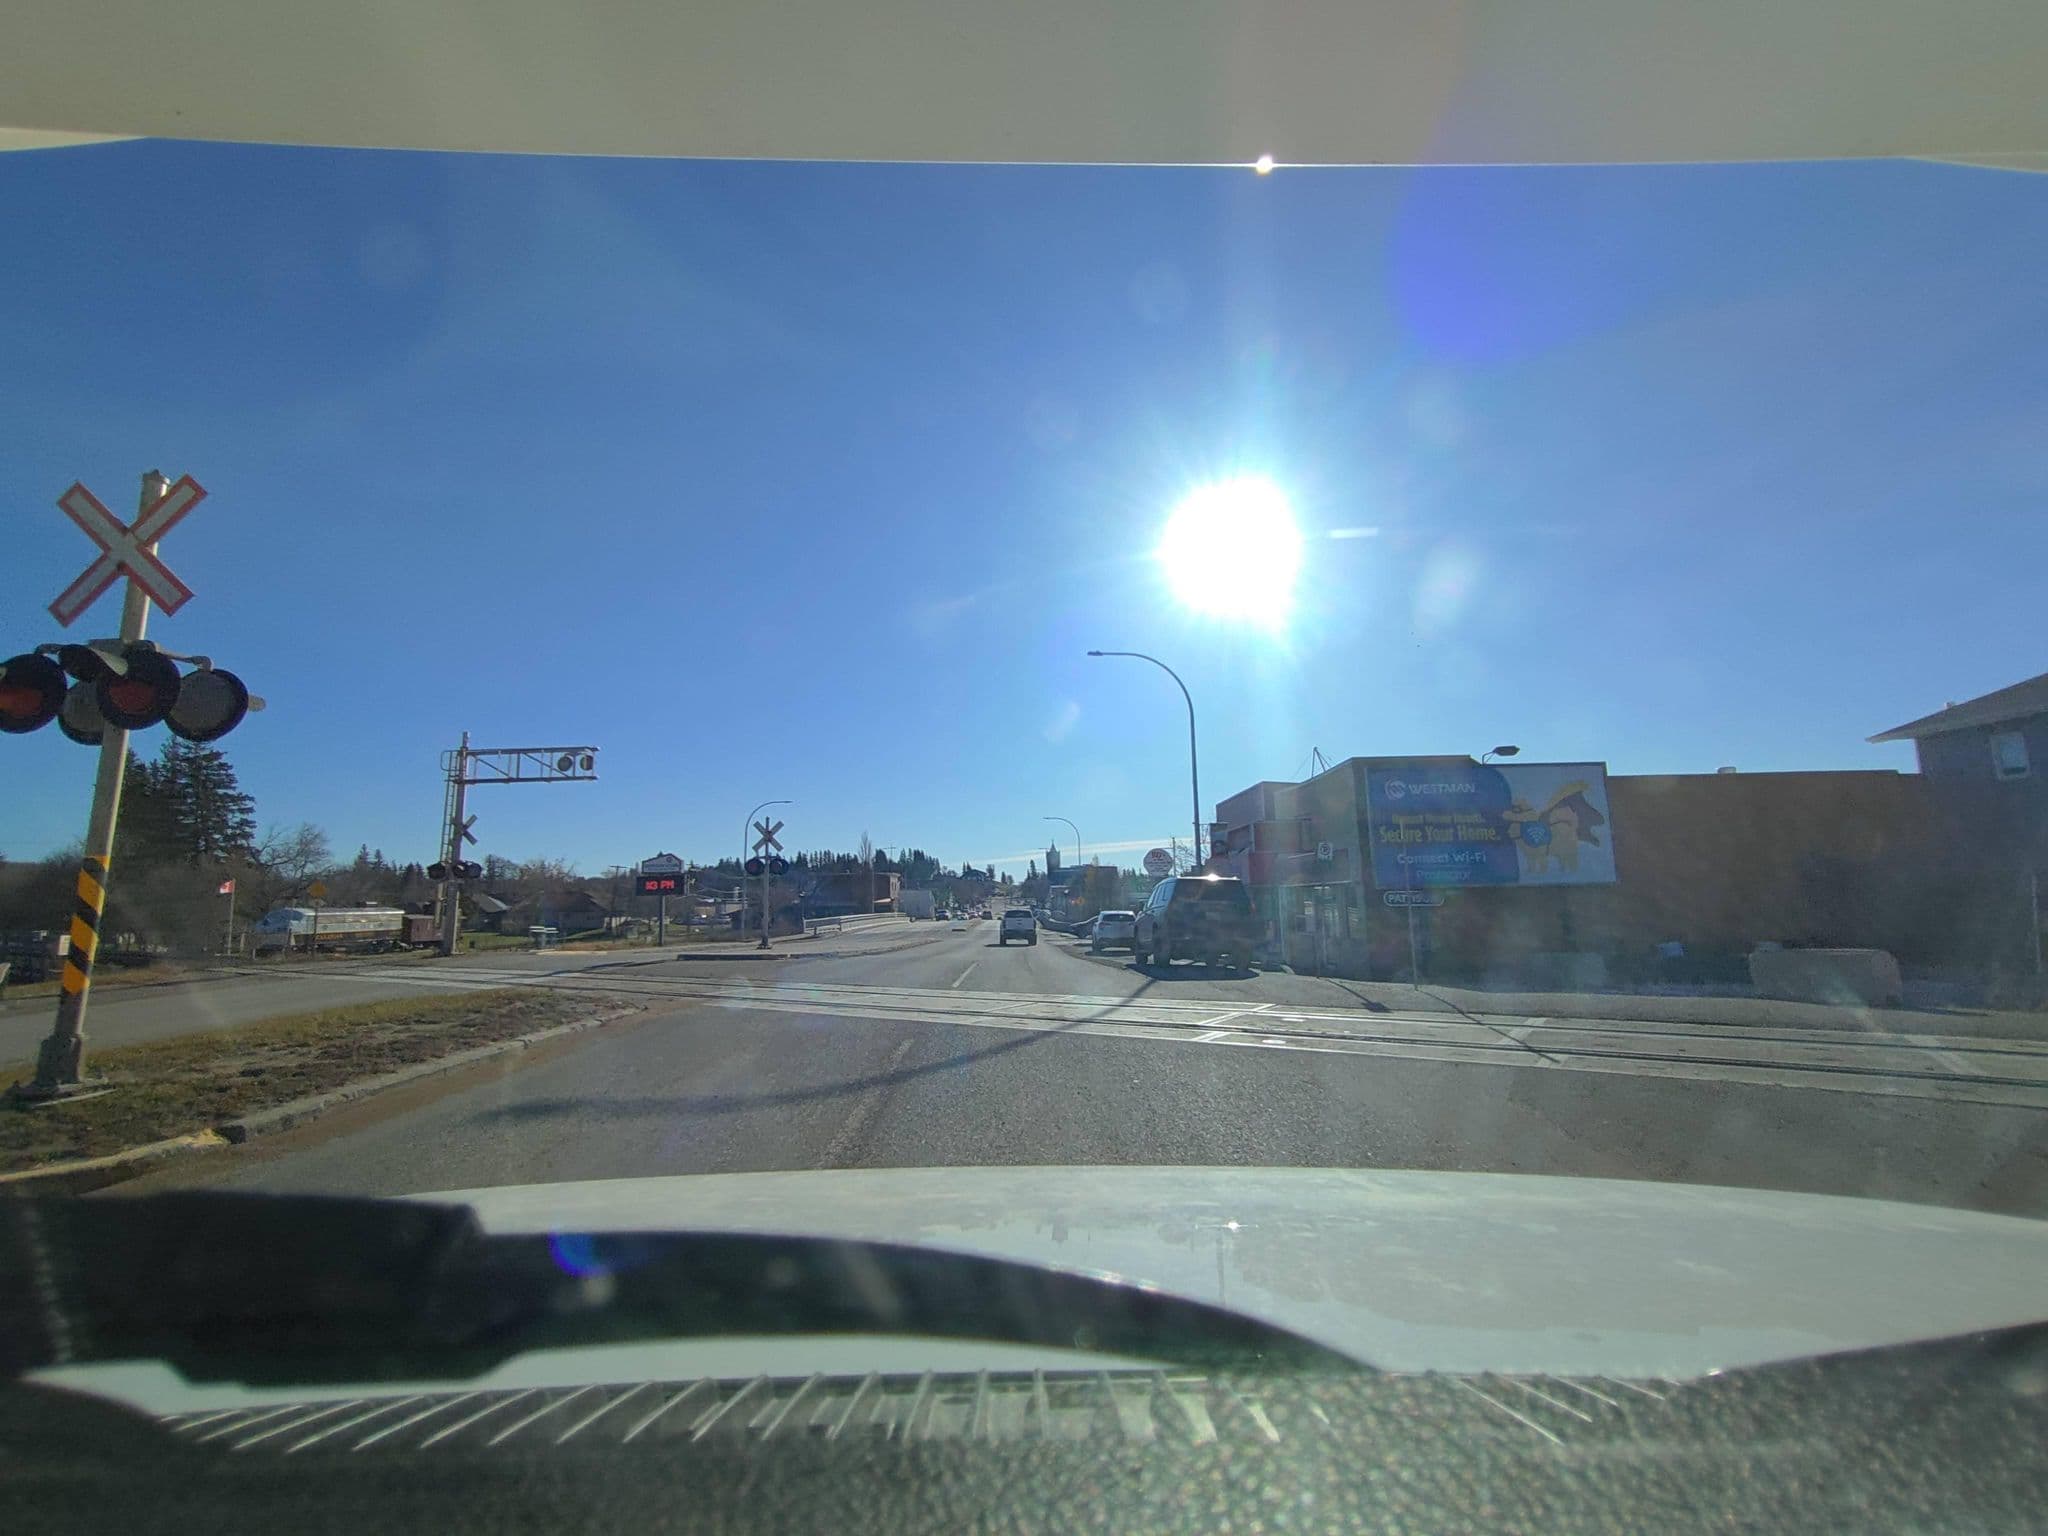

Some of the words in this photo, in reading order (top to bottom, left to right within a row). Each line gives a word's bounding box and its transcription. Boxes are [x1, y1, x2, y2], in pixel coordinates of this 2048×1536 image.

[1408, 783, 1476, 794] WESTMAN
[1380, 825, 1423, 843] Secure
[1425, 825, 1455, 842] Your
[1452, 850, 1487, 863] Wi-Fi
